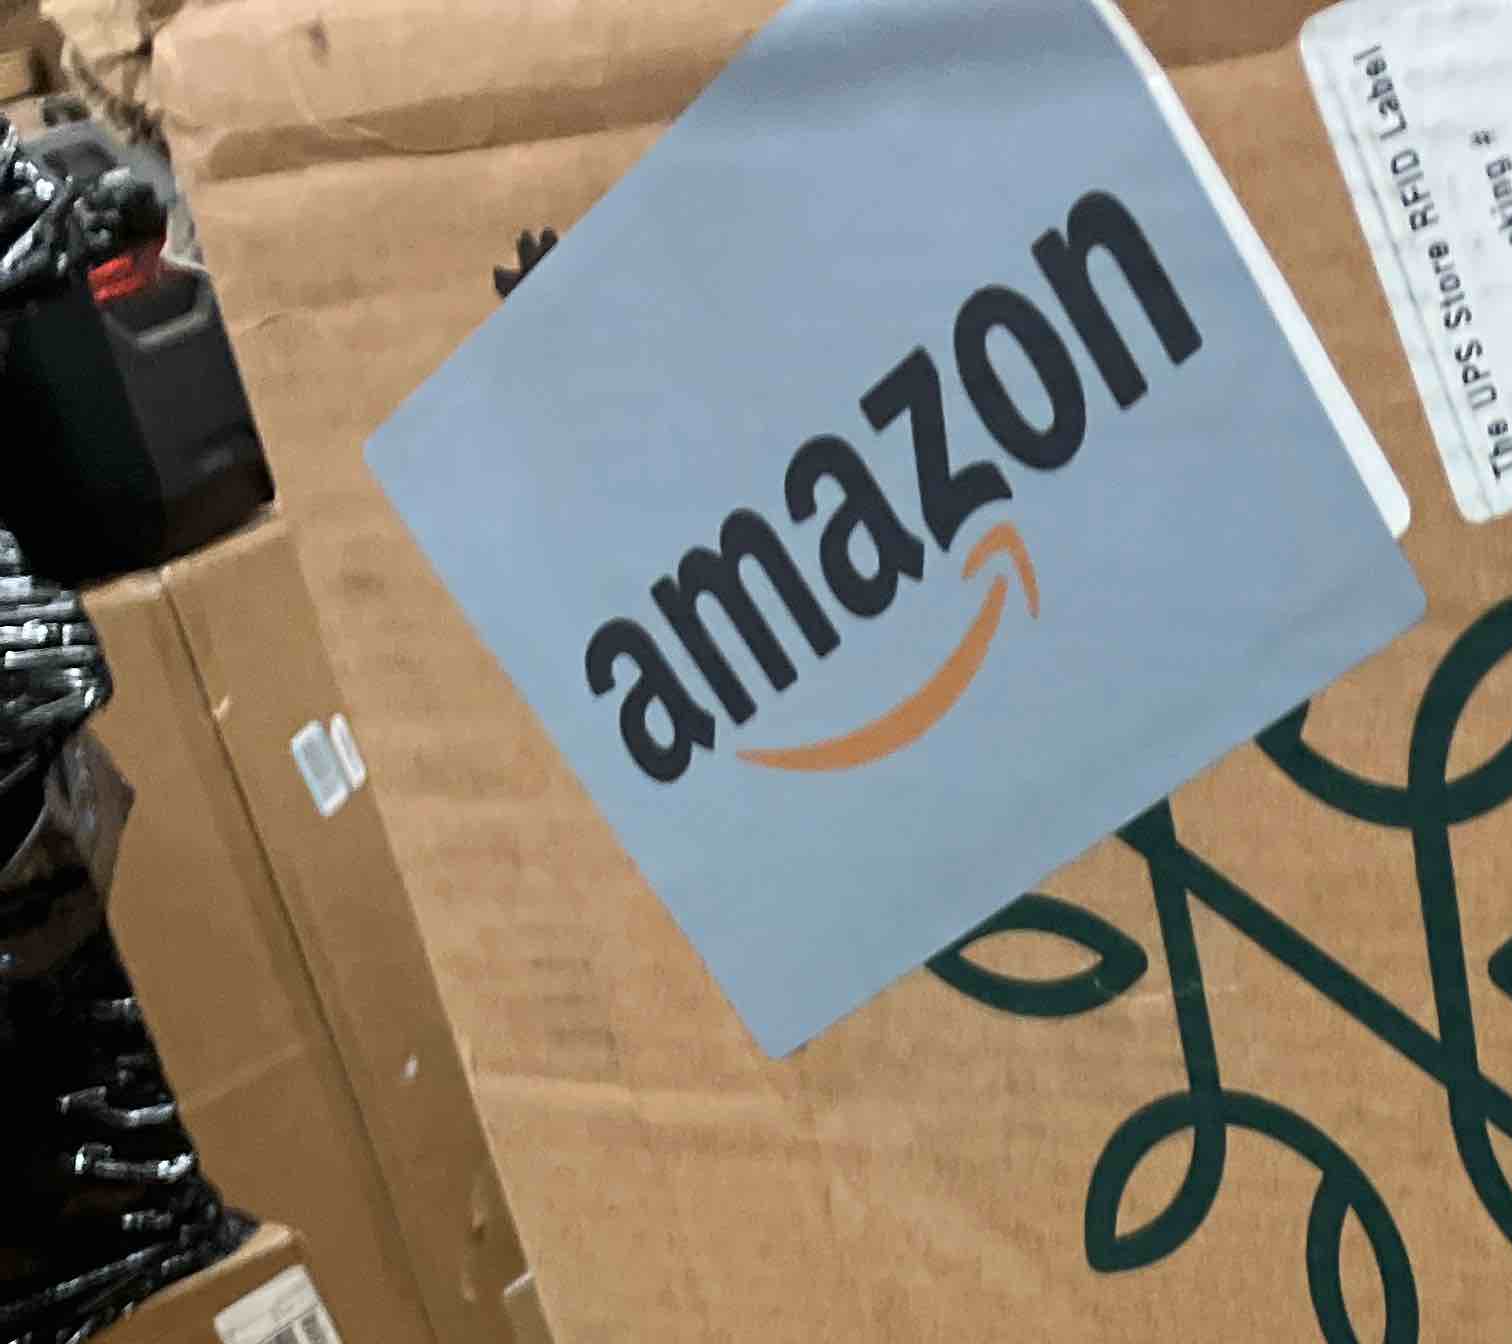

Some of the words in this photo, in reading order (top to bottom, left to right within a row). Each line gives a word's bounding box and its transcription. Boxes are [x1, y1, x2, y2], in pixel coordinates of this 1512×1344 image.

[1353, 43, 1406, 141] Label
[1392, 148, 1440, 232] RFID
[1428, 242, 1474, 330] Store
[1455, 341, 1498, 408] UPS
[584, 189, 1203, 784] amazon
